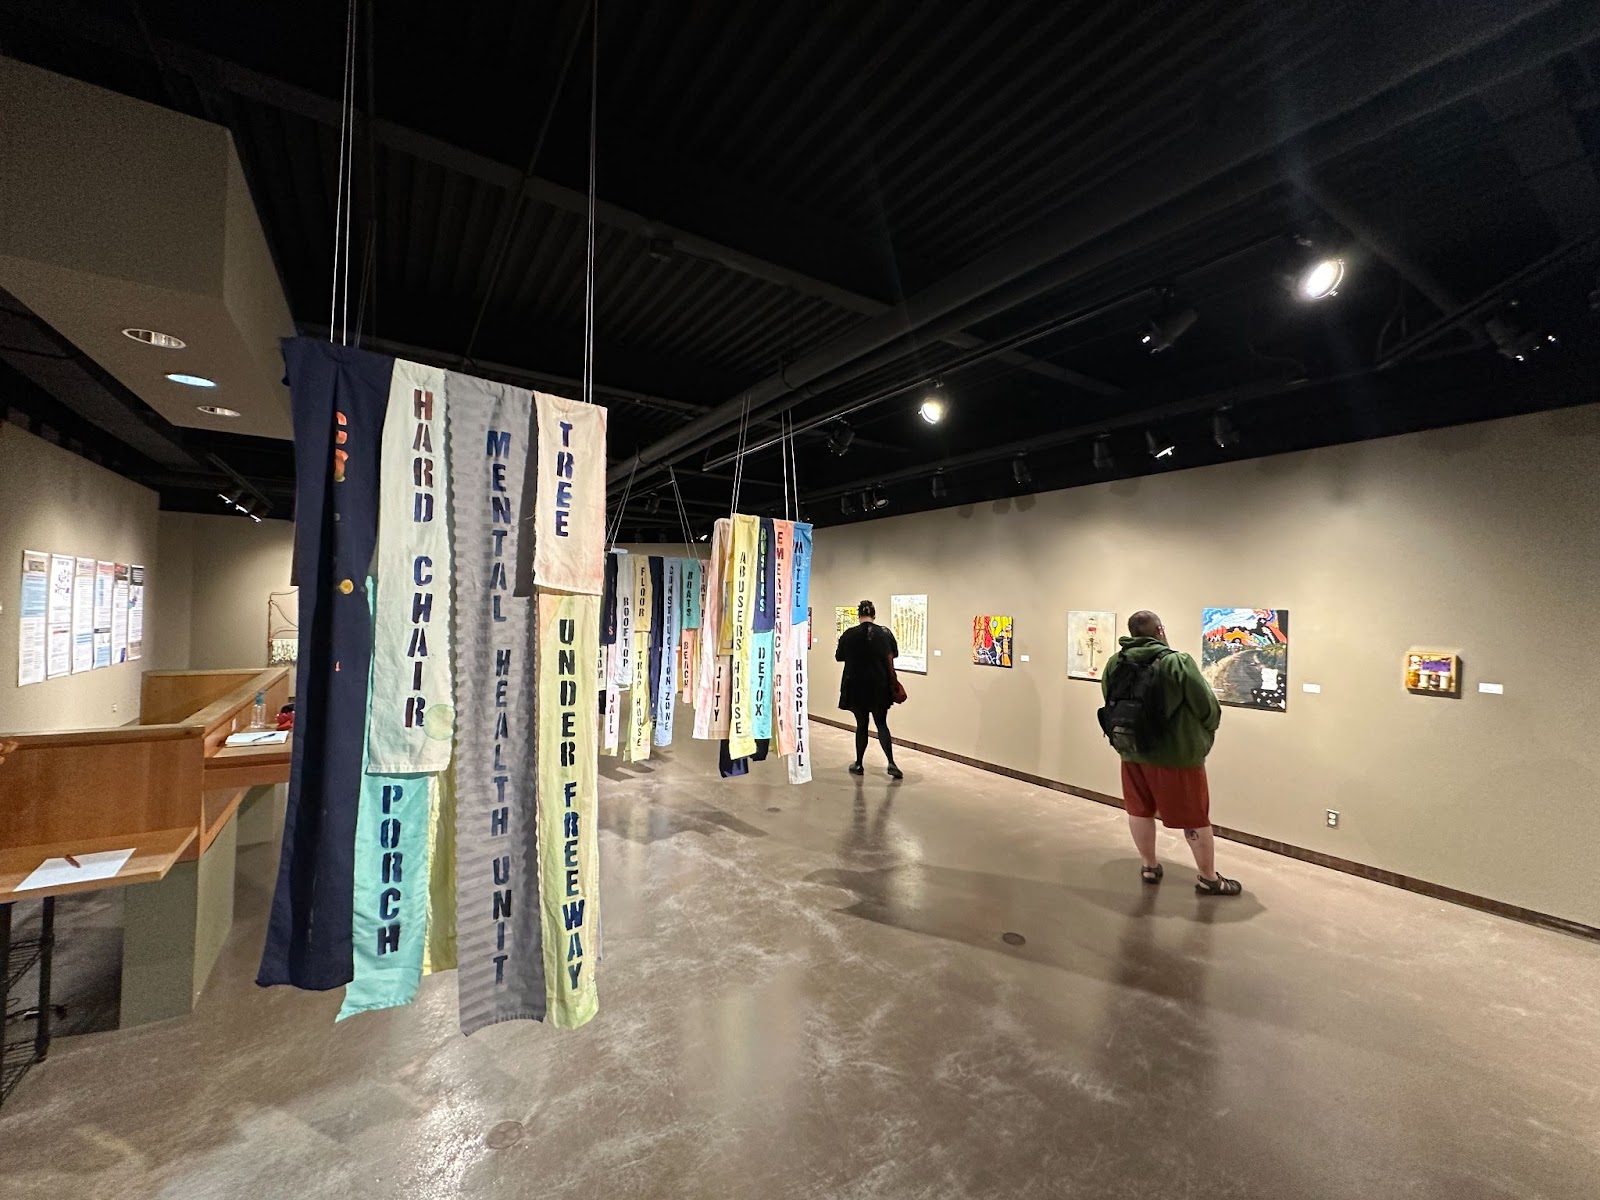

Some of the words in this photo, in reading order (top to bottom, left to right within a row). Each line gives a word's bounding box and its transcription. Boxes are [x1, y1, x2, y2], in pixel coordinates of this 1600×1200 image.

[412, 389, 434, 523] HARD
[555, 421, 573, 537] TREE
[486, 430, 511, 622] MENTAL
[794, 541, 804, 608] MOTEL
[405, 556, 434, 728] CHAIR
[638, 567, 646, 617] FLOOR
[686, 571, 694, 617] BOATS
[491, 649, 512, 836] HEALTH
[558, 619, 576, 767] UNDER
[733, 661, 742, 734] HOUSE
[755, 647, 766, 717] DETOX
[795, 659, 805, 767] HOSPITAL
[377, 785, 404, 956] PORCH
[492, 856, 512, 985] UNIT
[563, 781, 585, 990] FREEWAY
